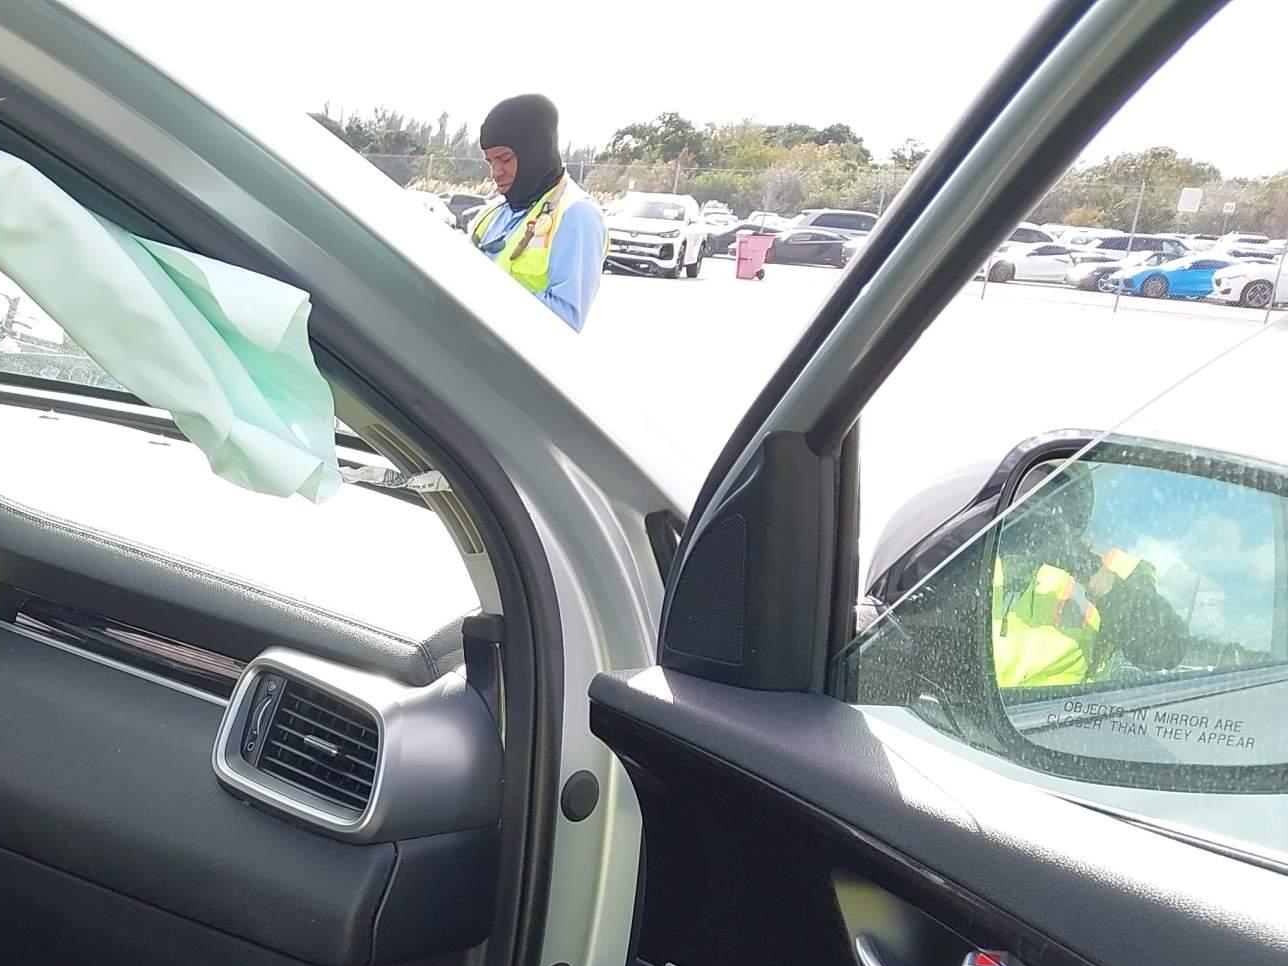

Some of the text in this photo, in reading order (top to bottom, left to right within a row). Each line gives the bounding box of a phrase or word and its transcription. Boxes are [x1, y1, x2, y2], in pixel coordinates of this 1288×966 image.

[1046, 713, 1256, 749] CLOSER THAN THEY APPEAR
[1063, 701, 1244, 733] OBJECTS IN MIRROR ARE
